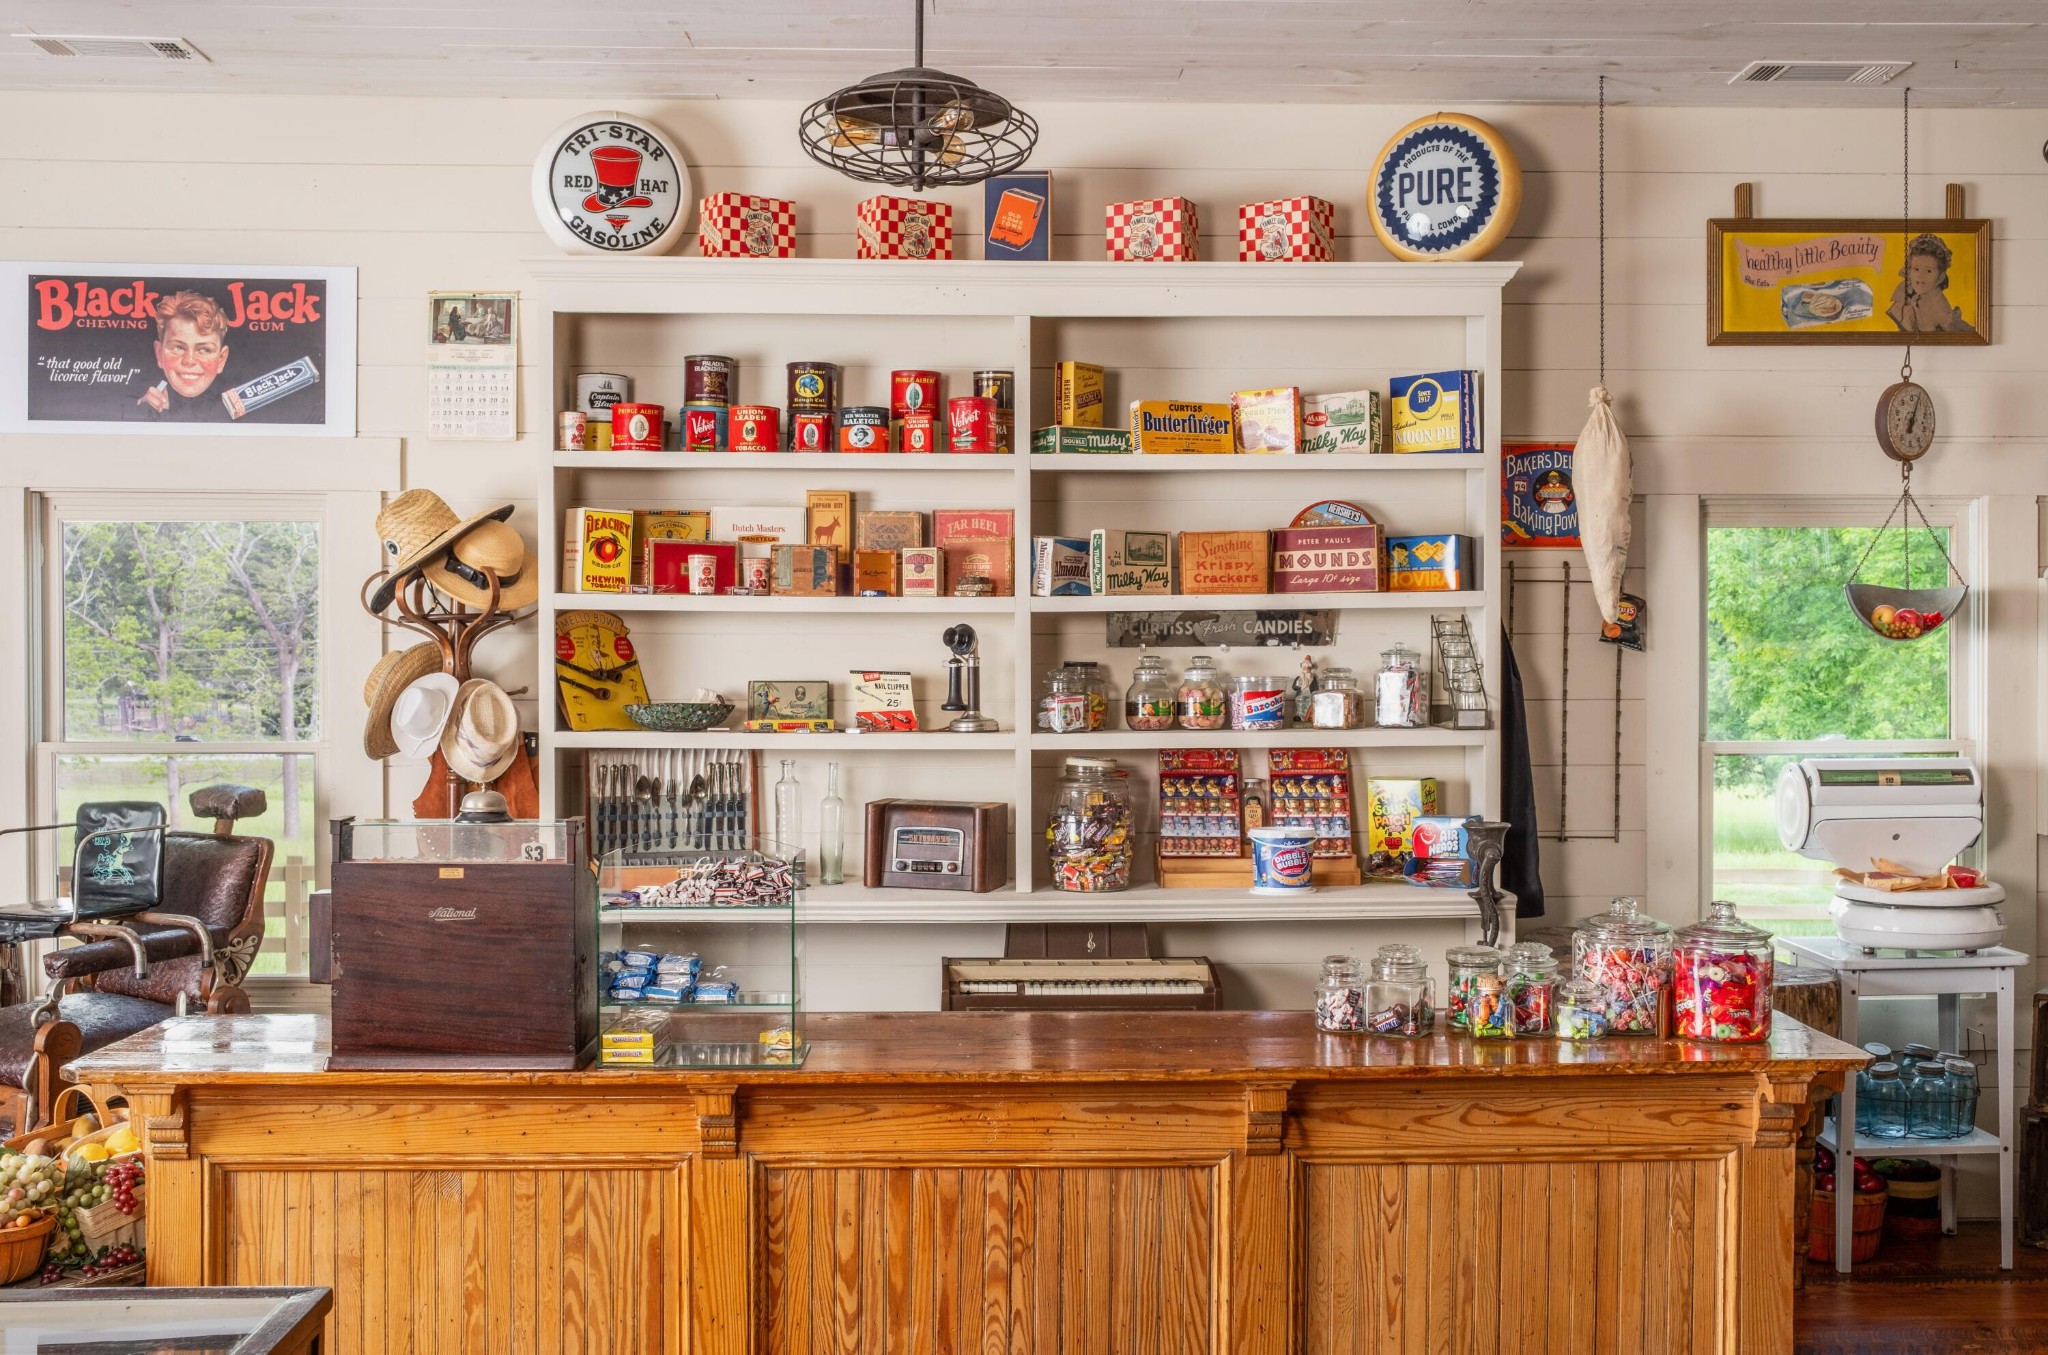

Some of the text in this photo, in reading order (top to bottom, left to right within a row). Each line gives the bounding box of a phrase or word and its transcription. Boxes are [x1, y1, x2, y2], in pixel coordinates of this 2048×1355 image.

[565, 125, 665, 161] TRI-STAR
[1403, 144, 1470, 168] PRODUCTS OF THE
[564, 175, 669, 193] RED HAT
[1398, 166, 1473, 209] PURE
[1001, 220, 1022, 230] TOWN
[1002, 216, 1024, 226] HOME
[570, 215, 665, 248] GASOLINE
[1746, 236, 1879, 274] healthy little Beauty
[34, 279, 321, 331] Black Jack
[76, 318, 285, 332] CHEWING GUM
[73, 357, 100, 372] good
[103, 357, 122, 369] old
[50, 368, 88, 382] licorice
[244, 378, 274, 398] Black
[272, 368, 296, 384] Jack
[591, 392, 620, 401] Captain
[1169, 404, 1202, 412] CURTISS
[692, 416, 715, 435] Velvet
[951, 409, 980, 428] Velvet
[1143, 411, 1230, 435] Butterfinger
[1306, 414, 1326, 424] MARS
[1087, 434, 1127, 450] Milky
[1301, 426, 1367, 453] Milky Way
[1394, 426, 1456, 446] MOON PIE
[1506, 452, 1552, 479] BAKER'S
[1328, 504, 1361, 521] HERSHEY'S
[1513, 494, 1553, 535] Baking
[585, 514, 631, 543] PEACHEY
[732, 524, 786, 532] Dutch Masters
[948, 518, 998, 534] TAR HEEL
[1198, 538, 1253, 559] Sunshine
[592, 560, 611, 569] RIBBON
[1196, 560, 1255, 572] Krispy
[1279, 551, 1372, 569] MOUNDS
[1054, 561, 1087, 578] Almond
[585, 575, 626, 584] CHEWING
[1107, 567, 1169, 590] Milky Way
[1193, 573, 1259, 584] Crackers
[1290, 574, 1361, 584] Large 10¢ size
[560, 613, 620, 630] MELLO BOWL
[1128, 617, 1313, 637] CURTISS Fresh CANDIES
[1374, 803, 1408, 815] SOUR
[1374, 812, 1410, 829] PATCH
[1440, 829, 1458, 841] AIR
[1429, 840, 1459, 856] HEADS
[1275, 852, 1306, 862] DUBBLE
[1277, 858, 1307, 869] BUBBLE
[428, 906, 477, 920] National
